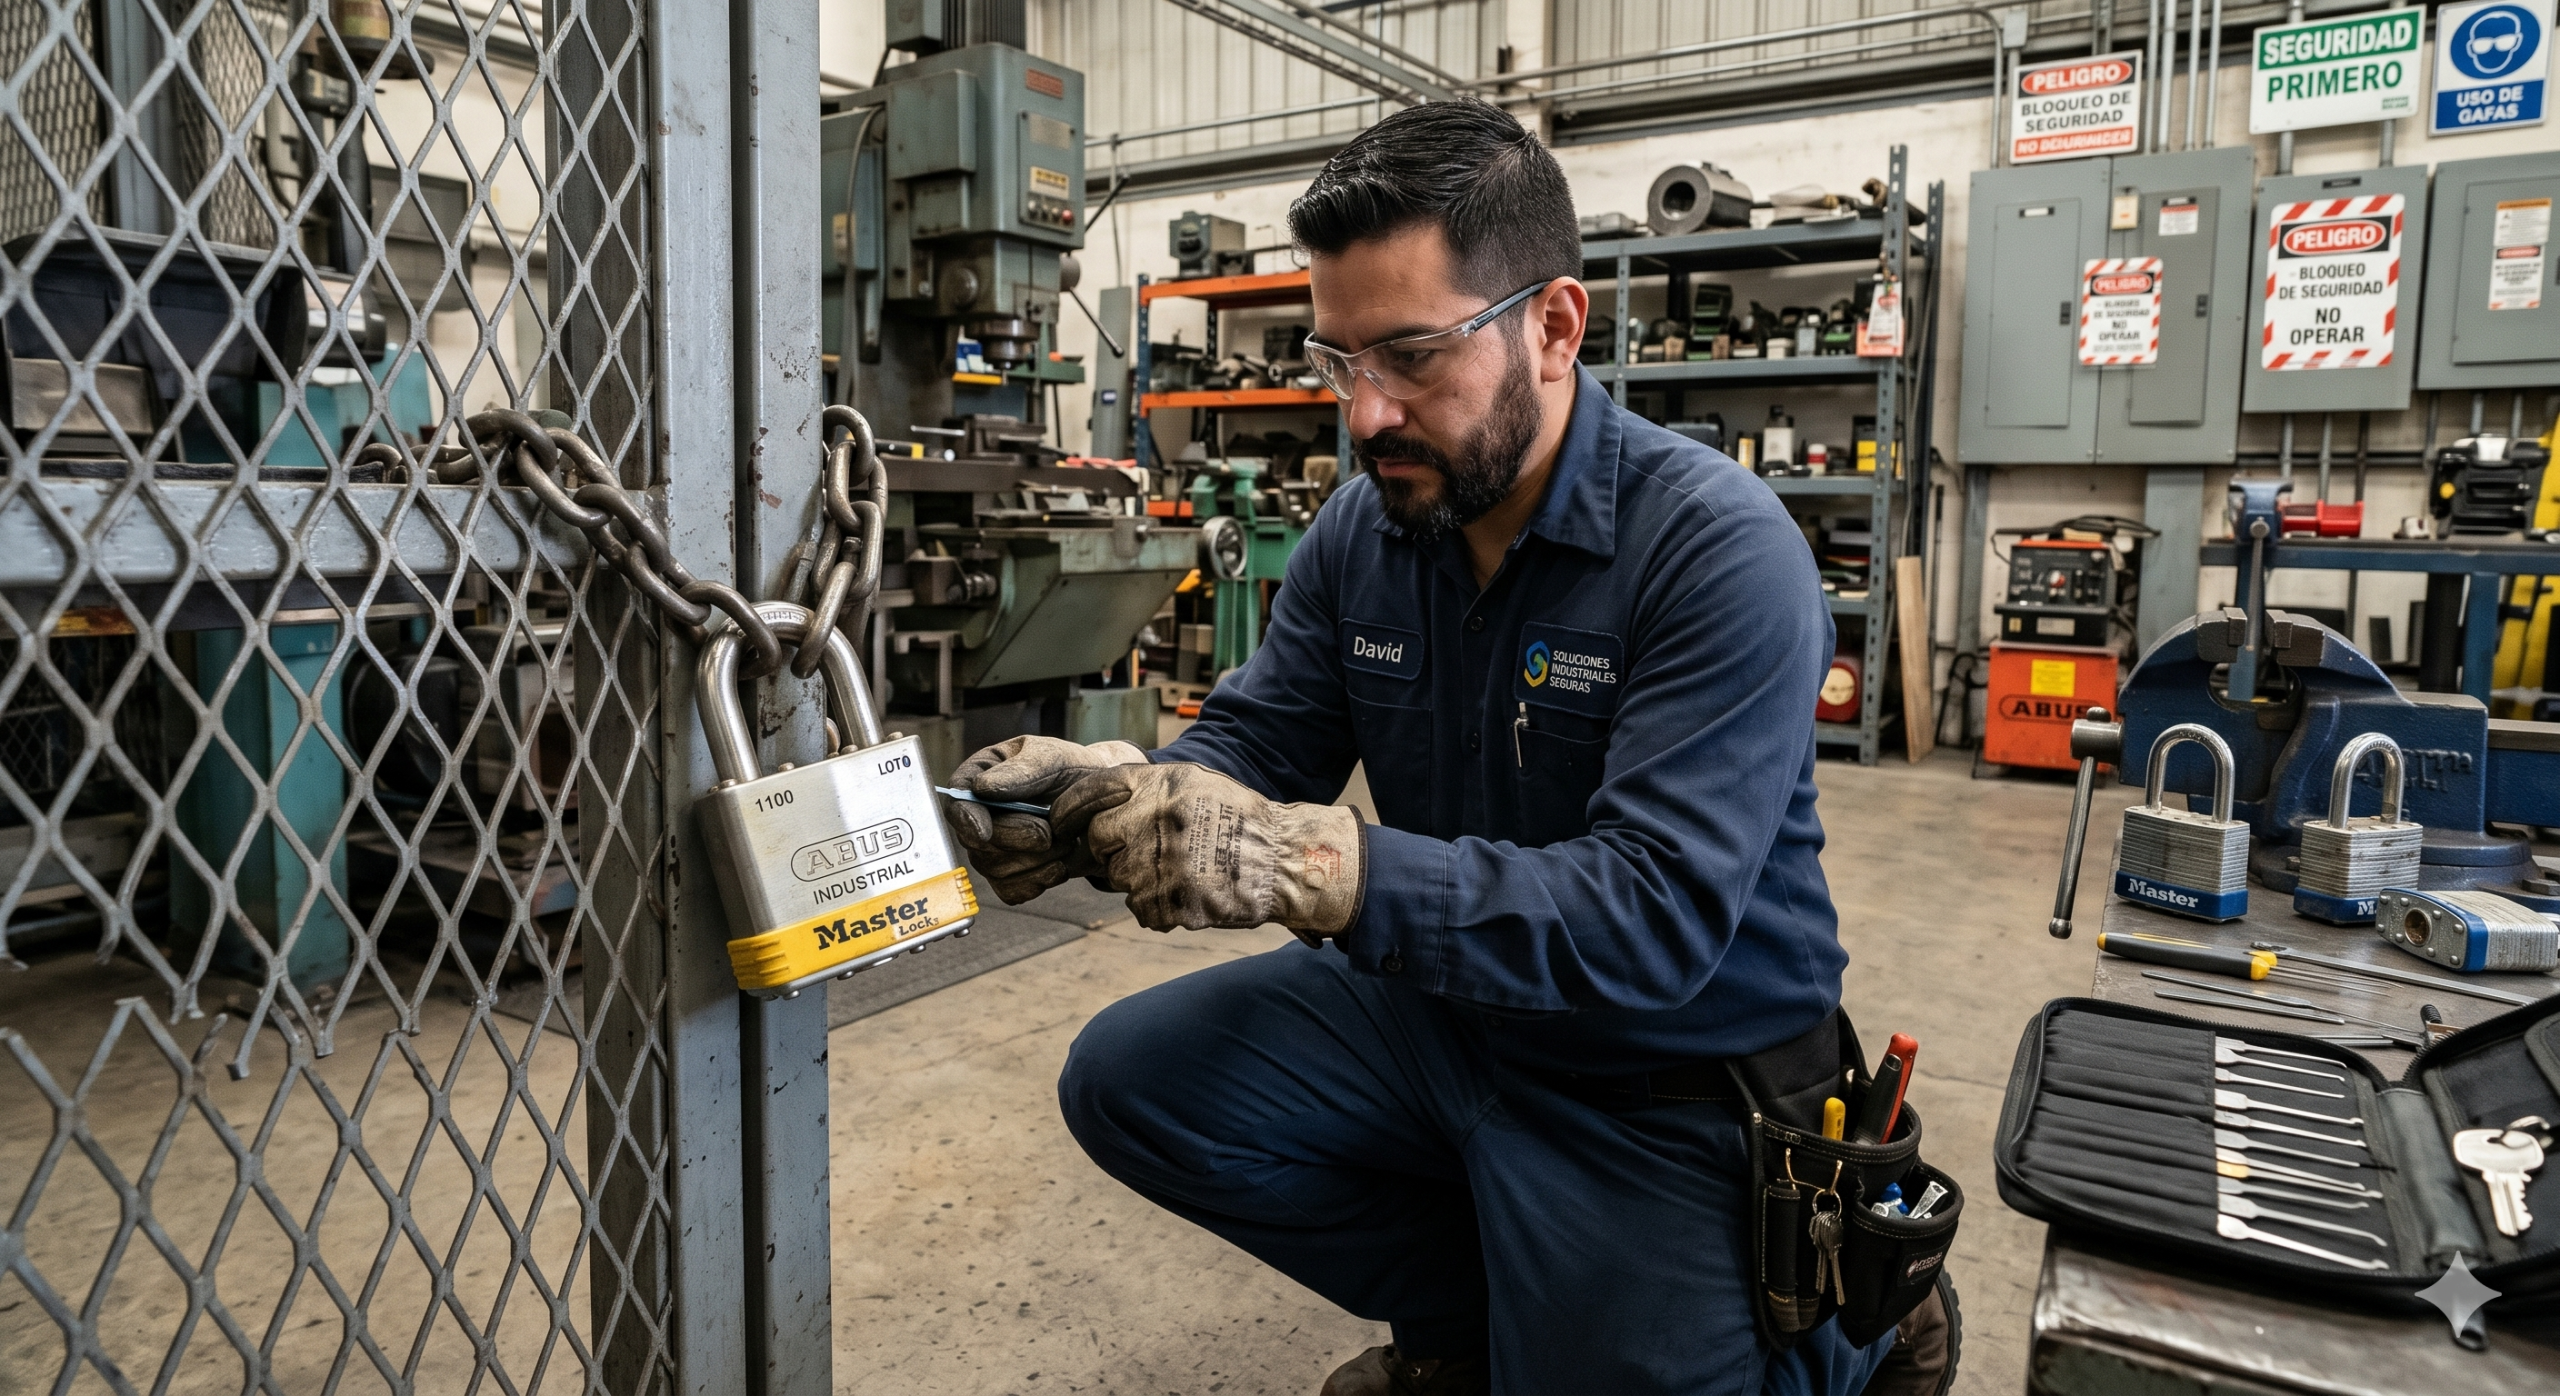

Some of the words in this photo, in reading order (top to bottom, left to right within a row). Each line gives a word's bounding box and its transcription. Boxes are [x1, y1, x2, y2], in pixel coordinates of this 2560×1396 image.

[2263, 19, 2413, 65] SEGURIDAD
[2032, 63, 2121, 91] PELIGRO
[2268, 61, 2403, 103] PRIMERO
[2021, 94, 2103, 116] BLOQUEO
[2110, 90, 2131, 105] DE
[2456, 89, 2495, 107] USO
[2498, 85, 2524, 103] DE
[2025, 109, 2123, 133] SEGURIDAD
[2457, 103, 2519, 124] GAFAS
[2292, 226, 2376, 250] PELIGRO
[2299, 263, 2365, 280] BLOQUEO
[2279, 286, 2297, 299] DE
[2301, 281, 2383, 299] SEGURIDAD
[2315, 307, 2341, 325] NO
[2290, 327, 2365, 345] OPERAR
[1353, 636, 1403, 663] David
[1553, 650, 1610, 669] SOLUCIONES
[1549, 676, 1591, 693] SEGURAS
[1551, 662, 1617, 684] INDUSTRIALES
[755, 789, 794, 812] 1100
[806, 825, 903, 875] ABUS
[813, 860, 914, 905] INDUSTRIAL
[2128, 878, 2199, 908] Master
[813, 897, 928, 950] Master
